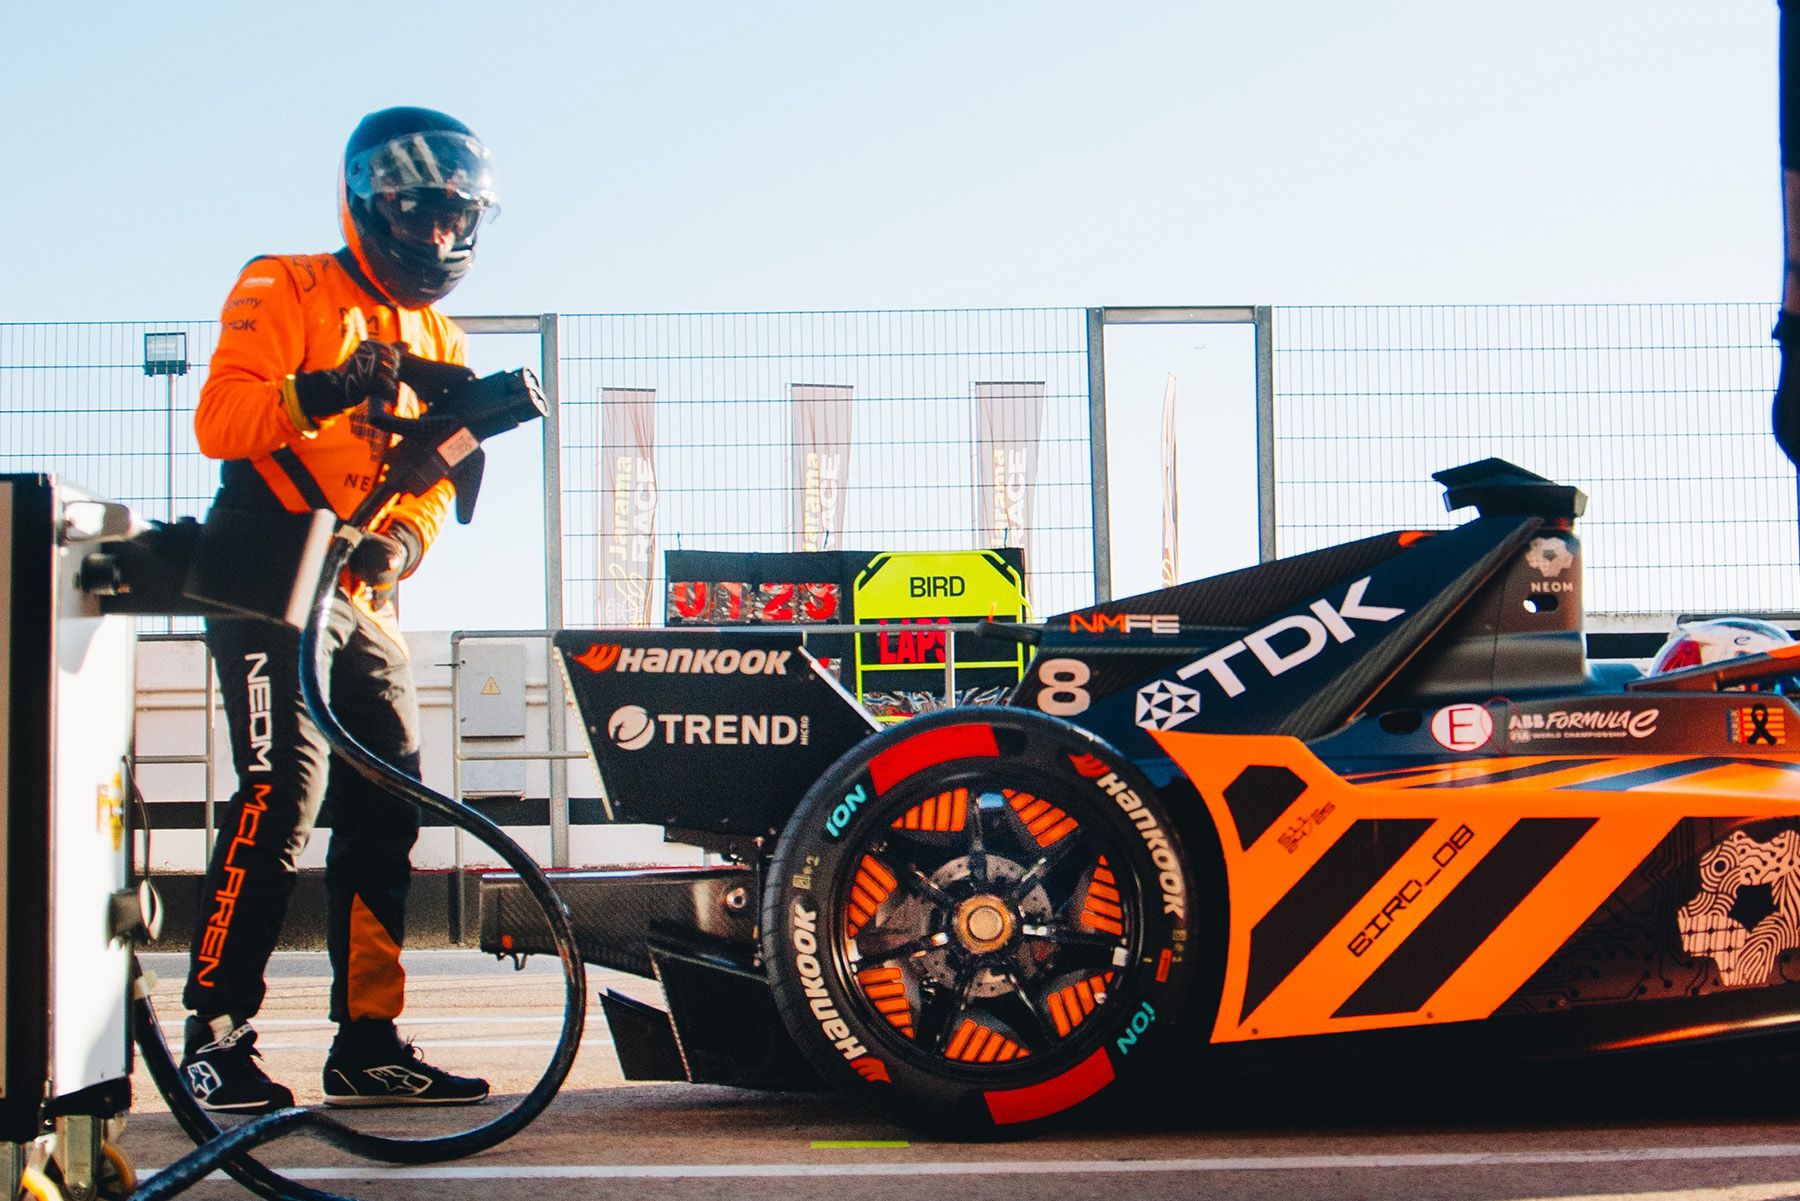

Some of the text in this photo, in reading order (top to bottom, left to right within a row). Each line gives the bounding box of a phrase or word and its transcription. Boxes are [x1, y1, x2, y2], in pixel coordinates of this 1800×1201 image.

[910, 575, 965, 598] BIRD
[1531, 581, 1573, 593] NEOM
[1069, 613, 1181, 635] NMFE
[1176, 576, 1406, 698] TDK
[1037, 658, 1091, 717] 8
[657, 714, 798, 745] TREND
[799, 715, 810, 747] MICRO
[1449, 707, 1477, 746] E
[1508, 713, 1545, 730] ABB
[1545, 710, 1630, 730] FORMULA
[197, 650, 273, 989] NEOM MCLAREN
[1347, 823, 1474, 959] BIRD_08
